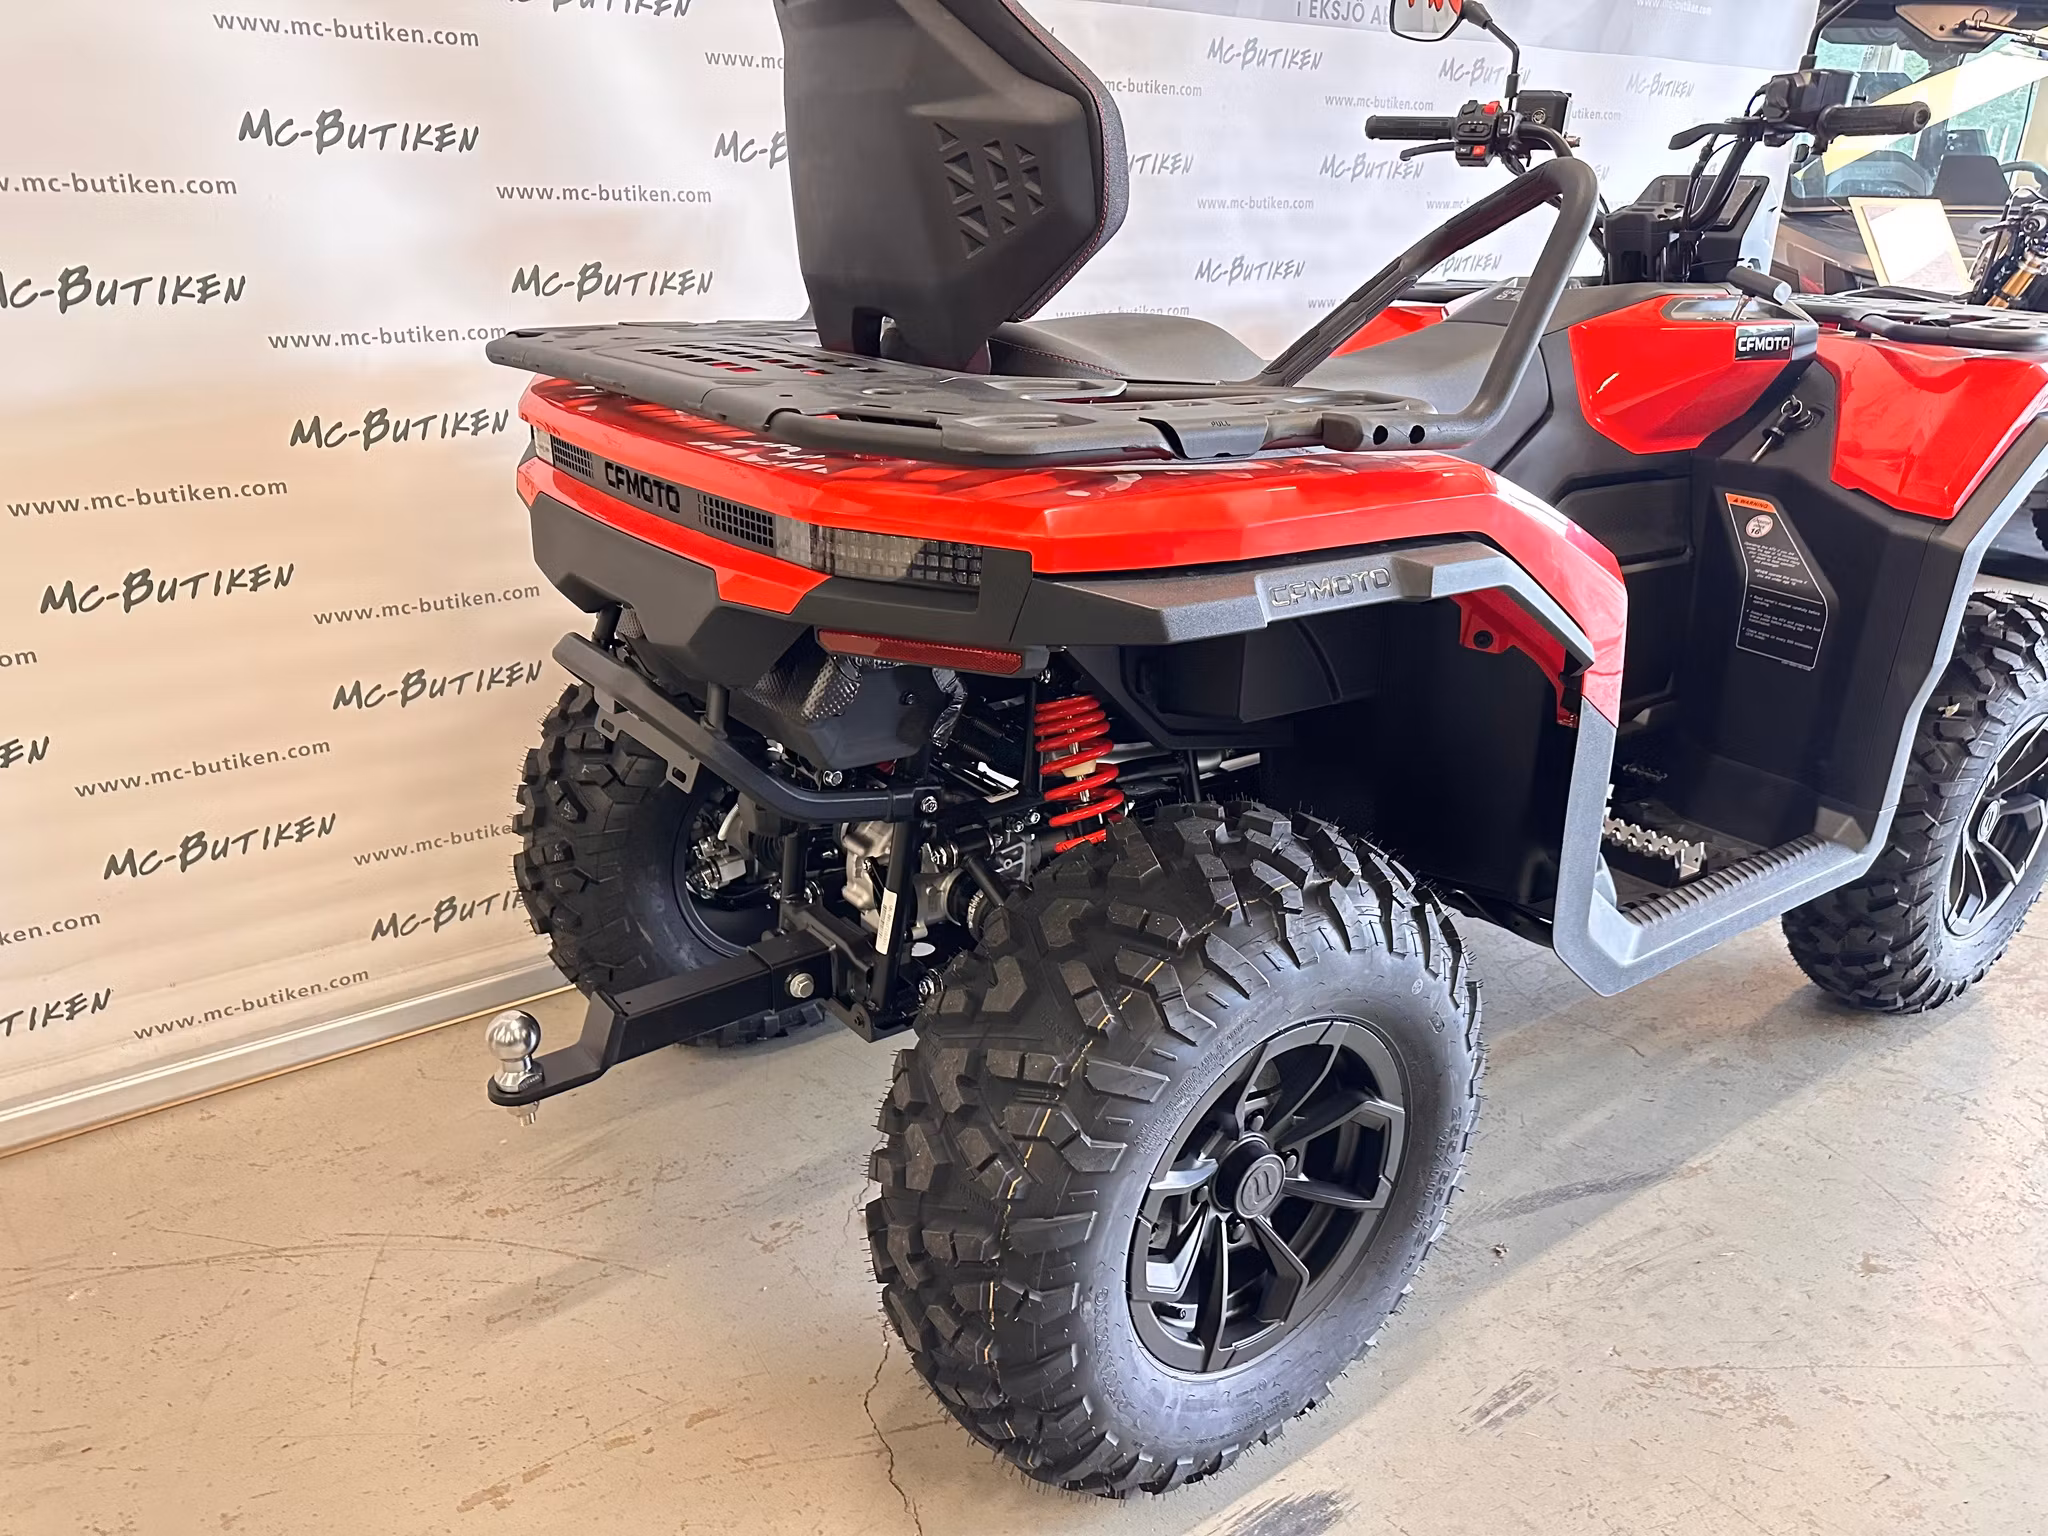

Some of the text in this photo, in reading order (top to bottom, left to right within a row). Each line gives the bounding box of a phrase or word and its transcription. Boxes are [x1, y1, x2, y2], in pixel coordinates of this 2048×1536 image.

[213, 15, 478, 46] www.mc-butiken.com
[1325, 95, 1434, 112] www.mc-butiken.com
[496, 184, 711, 202] www.mc-butiken.com
[1197, 196, 1314, 210] www.mc-butiken.com
[268, 326, 507, 350] www.mc-butiken.com
[1737, 336, 1791, 352] CFMOTO
[7, 482, 287, 516] www.mc-butiken.com
[604, 462, 681, 514] CFMOTO
[1269, 566, 1392, 608] CFMOTO
[314, 586, 539, 624] www.mc-butiken.com
[75, 742, 330, 797] www.mc-butiken.com
[133, 969, 369, 1040] www.mc-butiken.com
